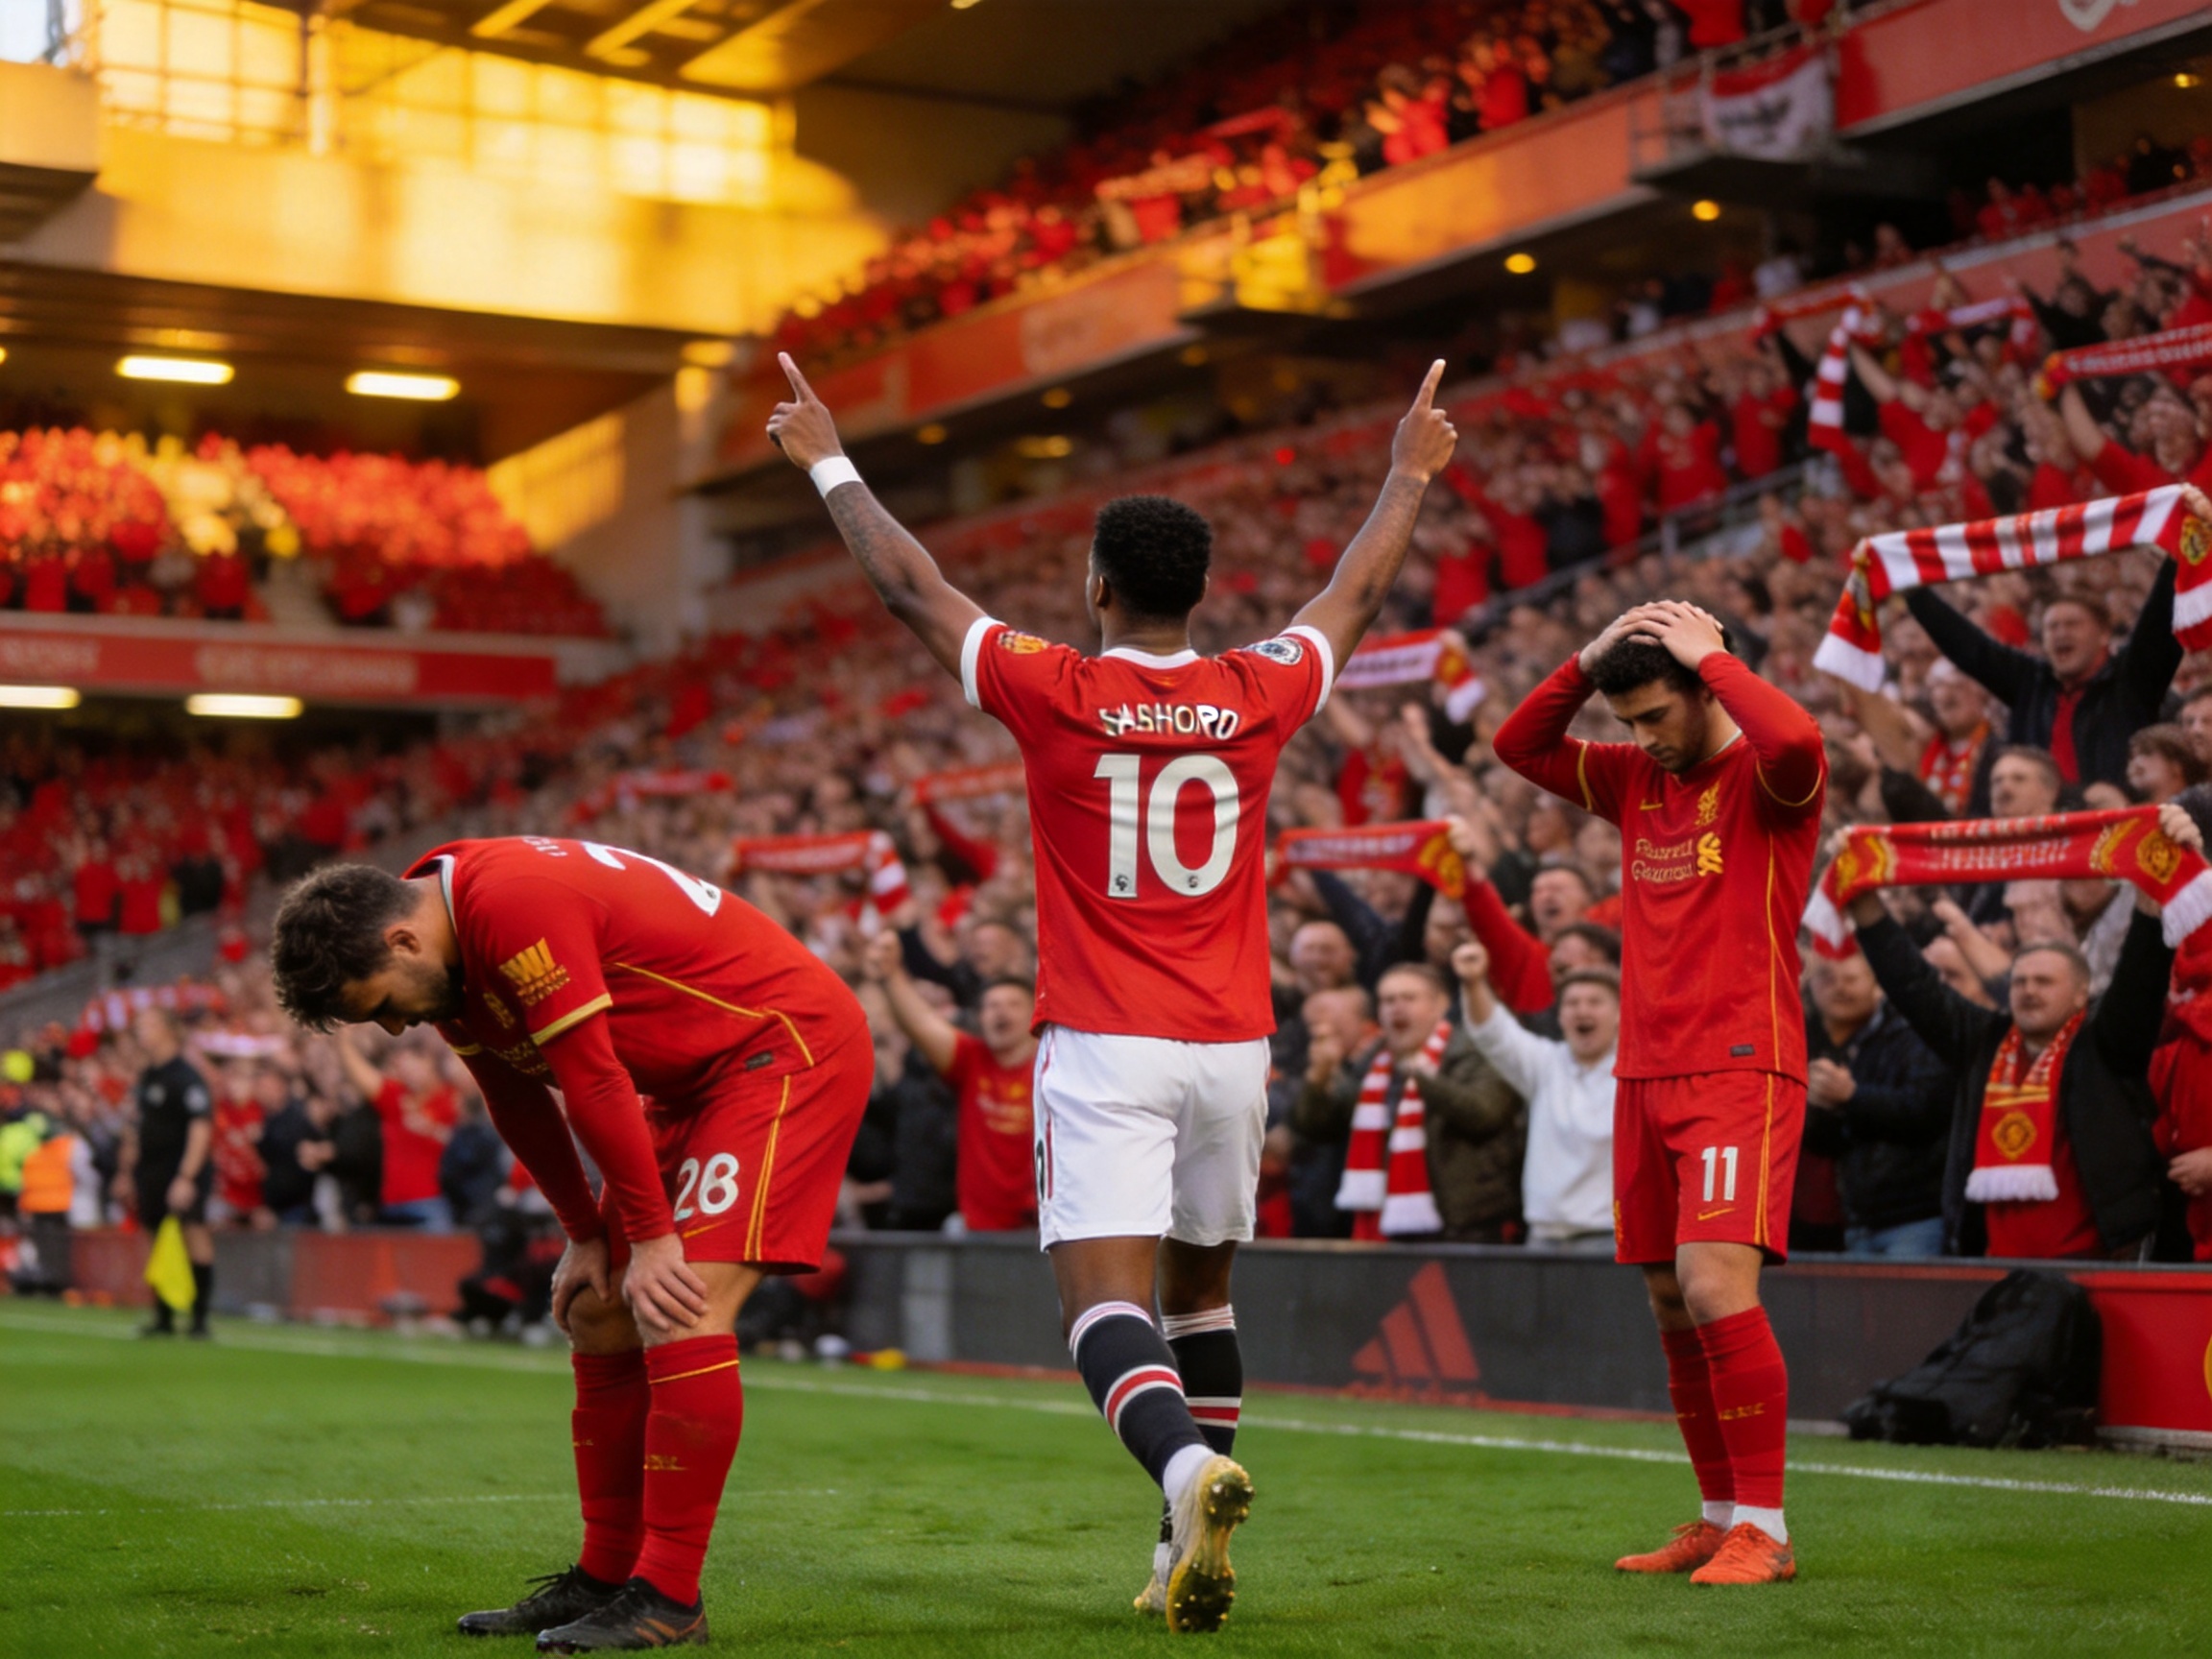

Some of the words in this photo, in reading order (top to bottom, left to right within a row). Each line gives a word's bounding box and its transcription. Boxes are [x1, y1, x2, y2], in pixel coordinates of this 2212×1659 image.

[1093, 754, 1240, 898] 10
[673, 1152, 740, 1222] 28
[1700, 1145, 1739, 1202] 11
